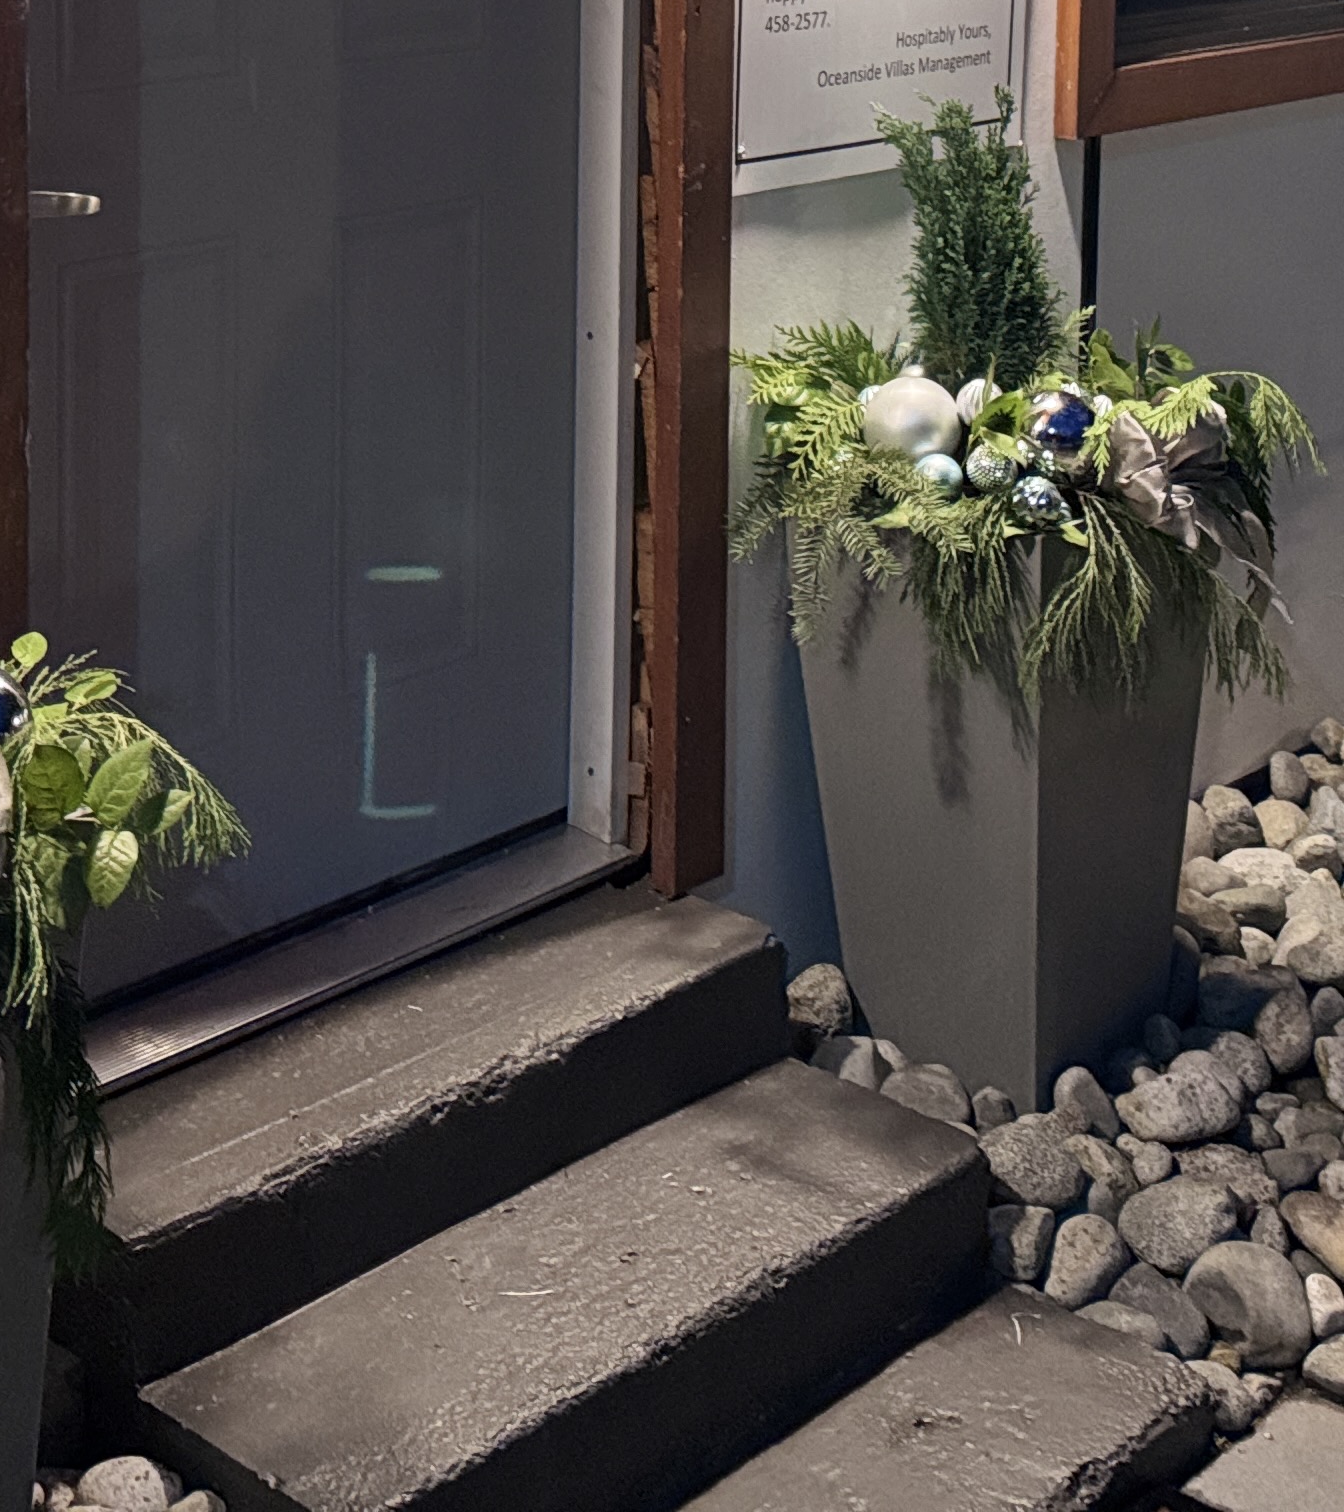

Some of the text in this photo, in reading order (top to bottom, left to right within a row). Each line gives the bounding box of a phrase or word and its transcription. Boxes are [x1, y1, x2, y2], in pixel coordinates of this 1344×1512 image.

[764, 10, 832, 34] 458-2577.
[896, 23, 992, 49] Hospitably Yours,
[817, 49, 992, 88] Oceanside Villas Management
